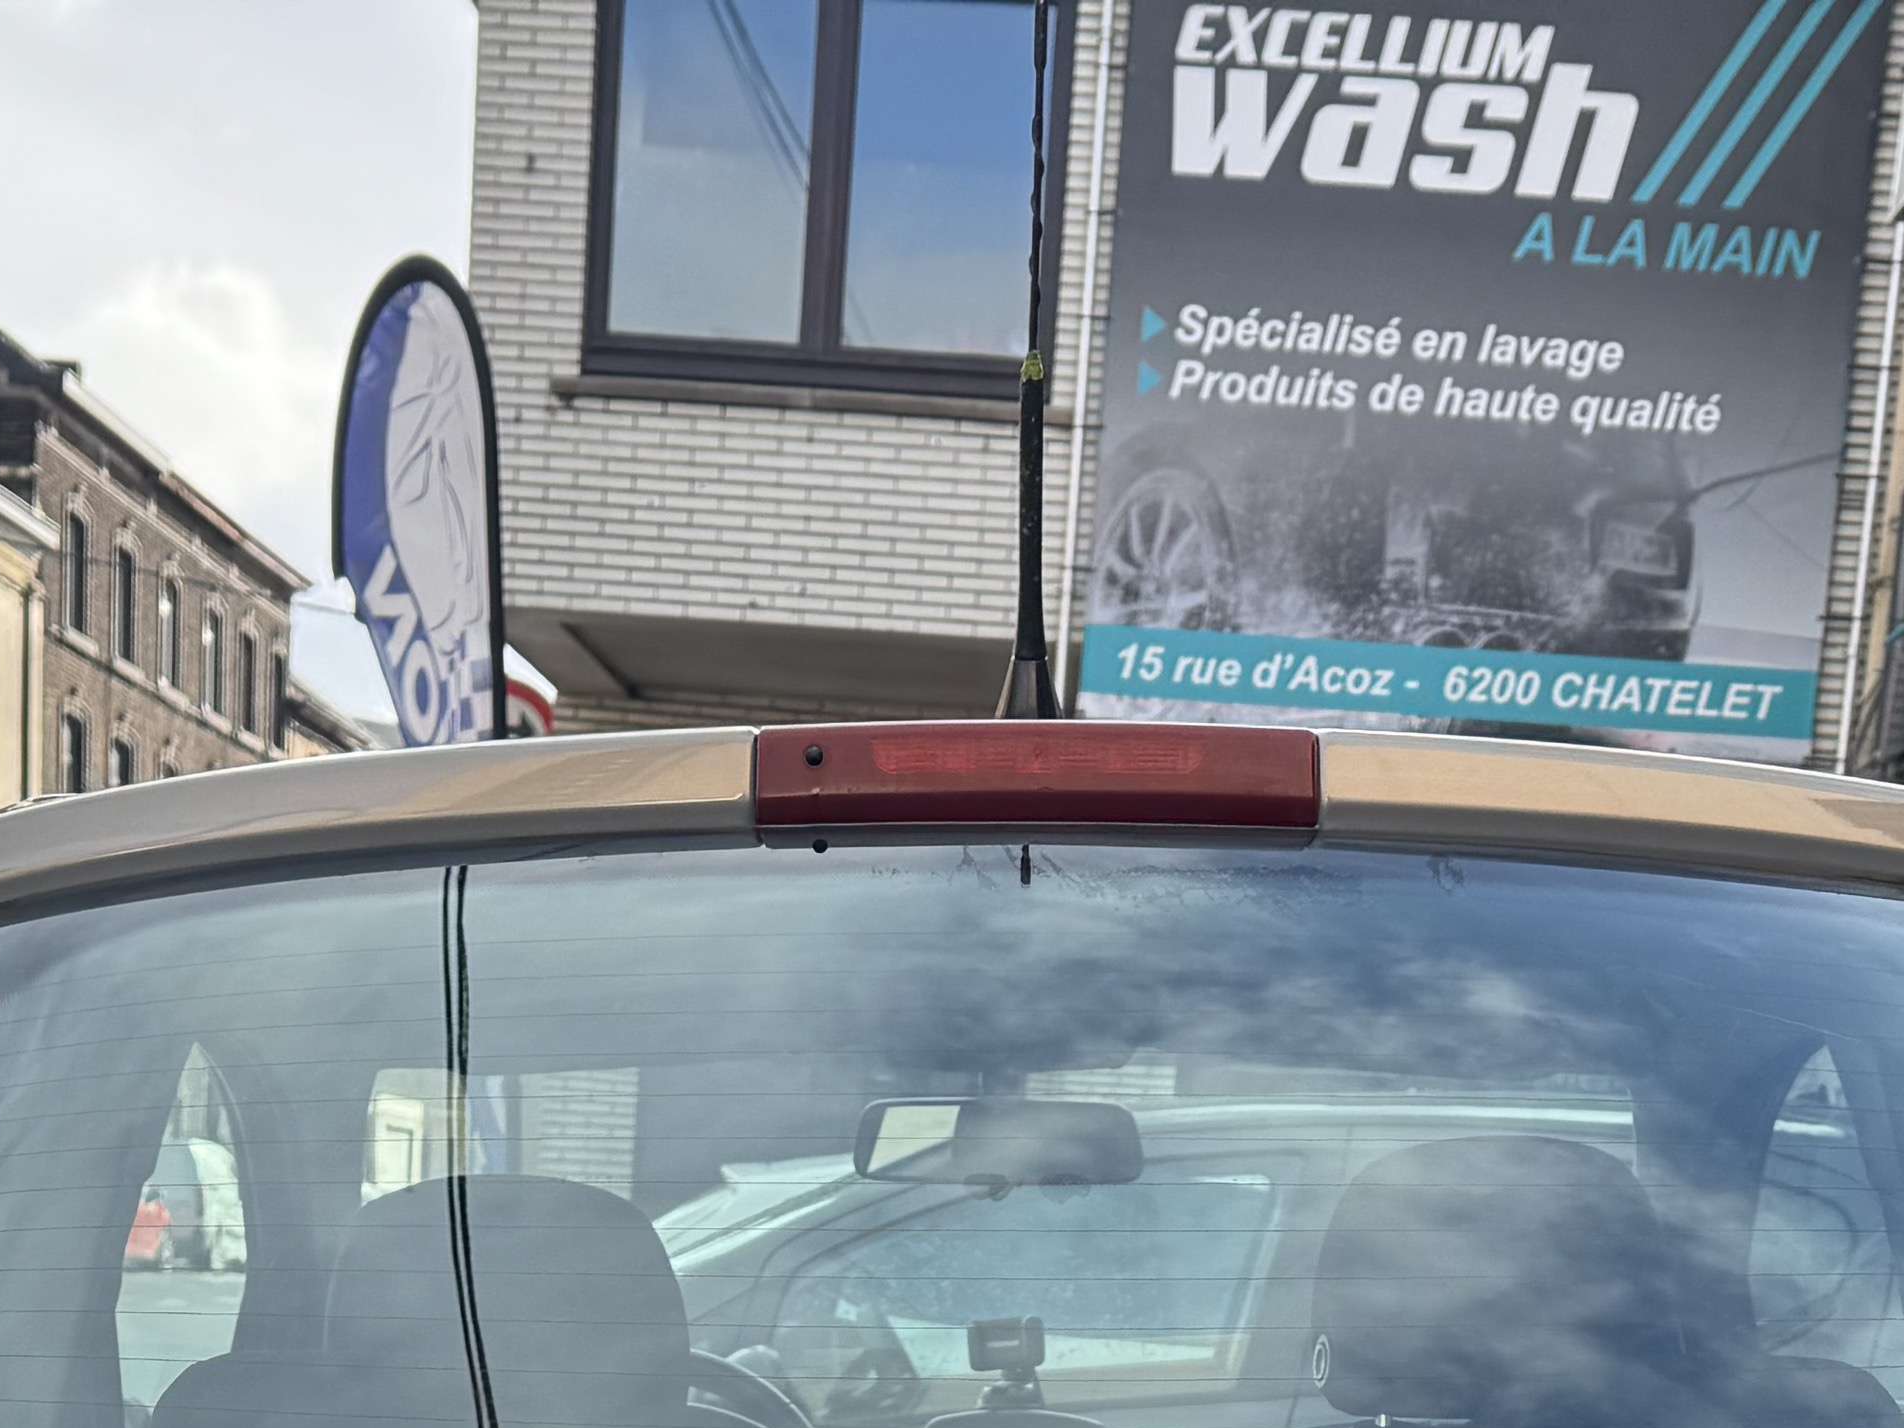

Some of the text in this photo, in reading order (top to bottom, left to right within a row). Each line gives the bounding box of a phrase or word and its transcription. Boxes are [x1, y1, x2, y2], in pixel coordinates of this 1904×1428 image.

[1175, 5, 1555, 83] EXCELLIUM
[1171, 62, 1640, 201] wash
[1512, 212, 1821, 279] A LA MAIN
[1173, 304, 1624, 380] Spécialisé en lavage
[1169, 359, 1721, 437] Produits de haute qualité
[1115, 642, 1164, 681] 15
[1172, 654, 1239, 691] rue
[1442, 670, 1538, 711] 6200
[1550, 673, 1782, 722] CHATELET
